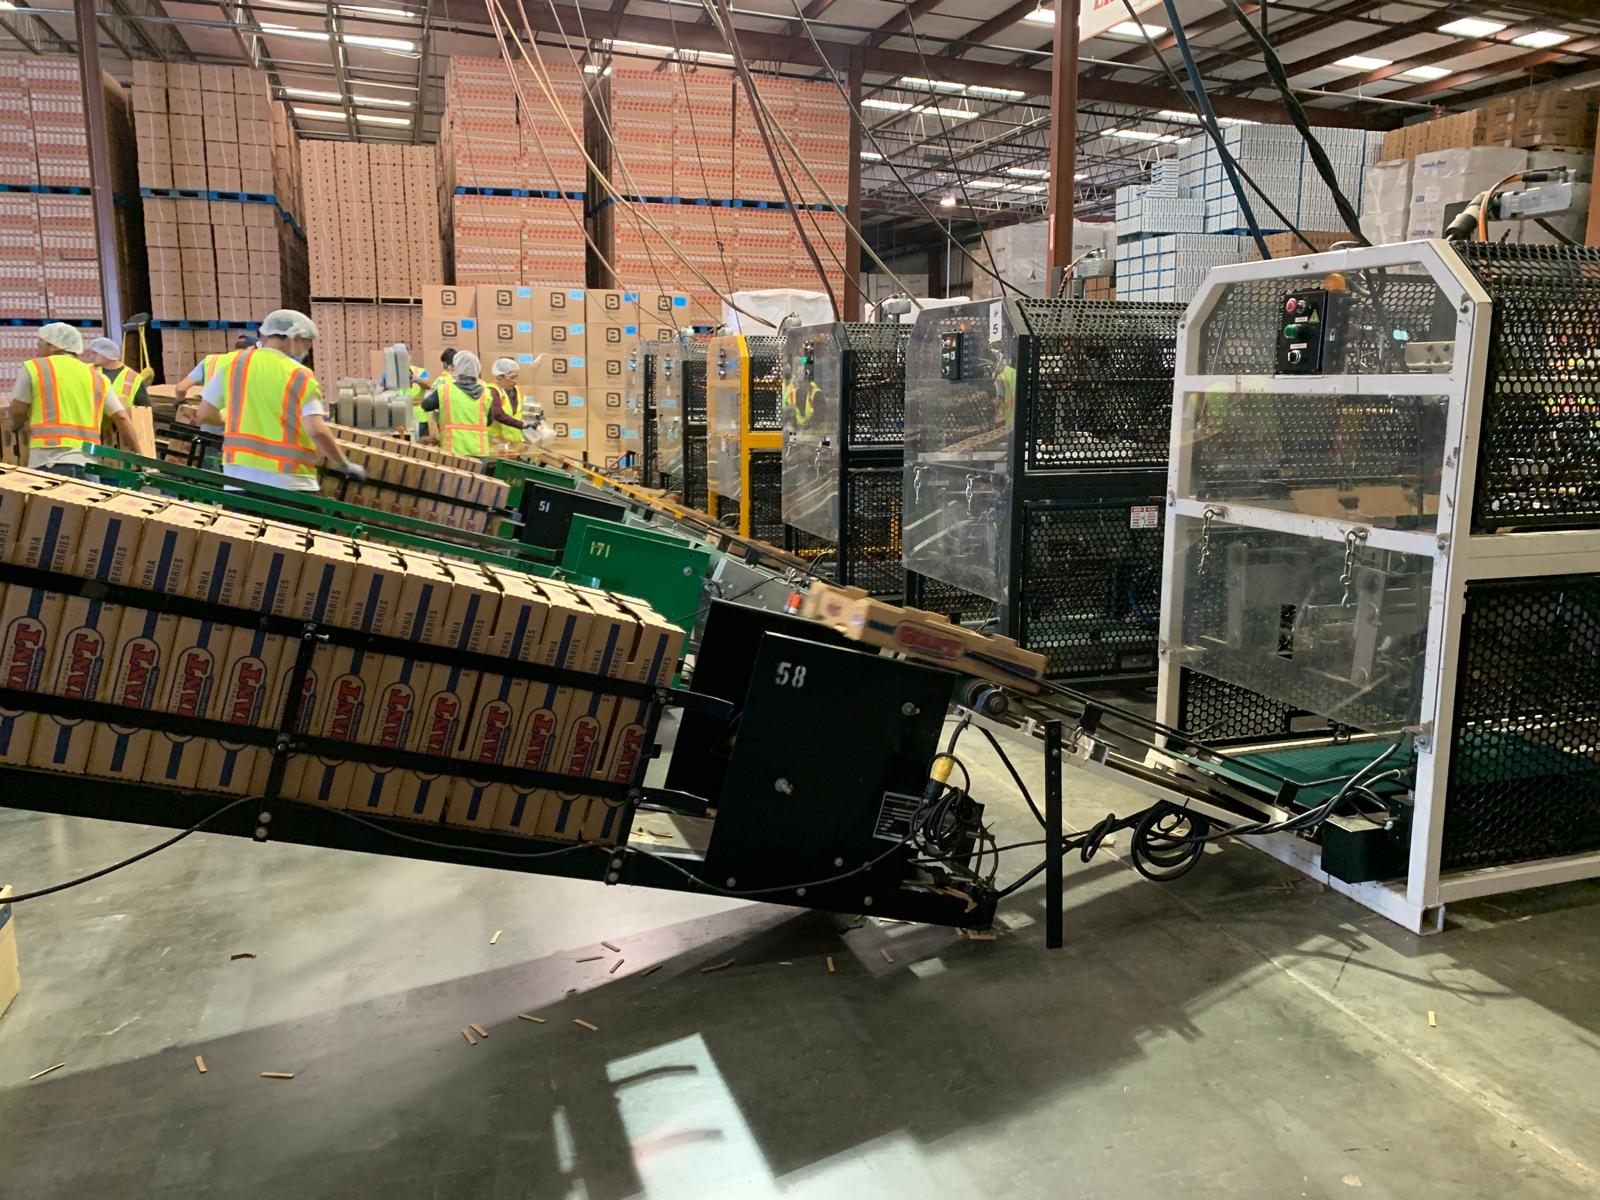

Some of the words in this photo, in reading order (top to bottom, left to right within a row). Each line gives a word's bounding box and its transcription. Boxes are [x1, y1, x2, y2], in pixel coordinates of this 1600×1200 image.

[538, 500, 550, 512] 51
[24, 537, 42, 567] ORNIA
[53, 535, 71, 571] BERRIES
[590, 541, 610, 558] 171
[111, 546, 128, 582] BERRIES
[143, 560, 156, 588] ORNIA
[168, 558, 184, 593] BERRIES
[196, 571, 211, 600] ORNIA
[221, 569, 237, 604] BERRIES
[274, 580, 290, 614] BERRIES
[302, 592, 316, 620] ORNIA
[325, 590, 341, 624] BERRIES
[351, 602, 364, 630] ORNIA
[372, 600, 389, 632] BERRIES
[400, 612, 414, 640] ORNIA
[423, 610, 438, 642] BERRIES
[448, 622, 462, 646] ORNIA
[469, 620, 485, 652] BERRIES
[500, 631, 512, 656] ORNIA
[521, 629, 536, 660] BERRIES
[546, 640, 558, 664] ORNIA
[592, 649, 602, 672] ORNIA
[640, 658, 651, 681] ORNIA
[776, 662, 806, 688] 58
